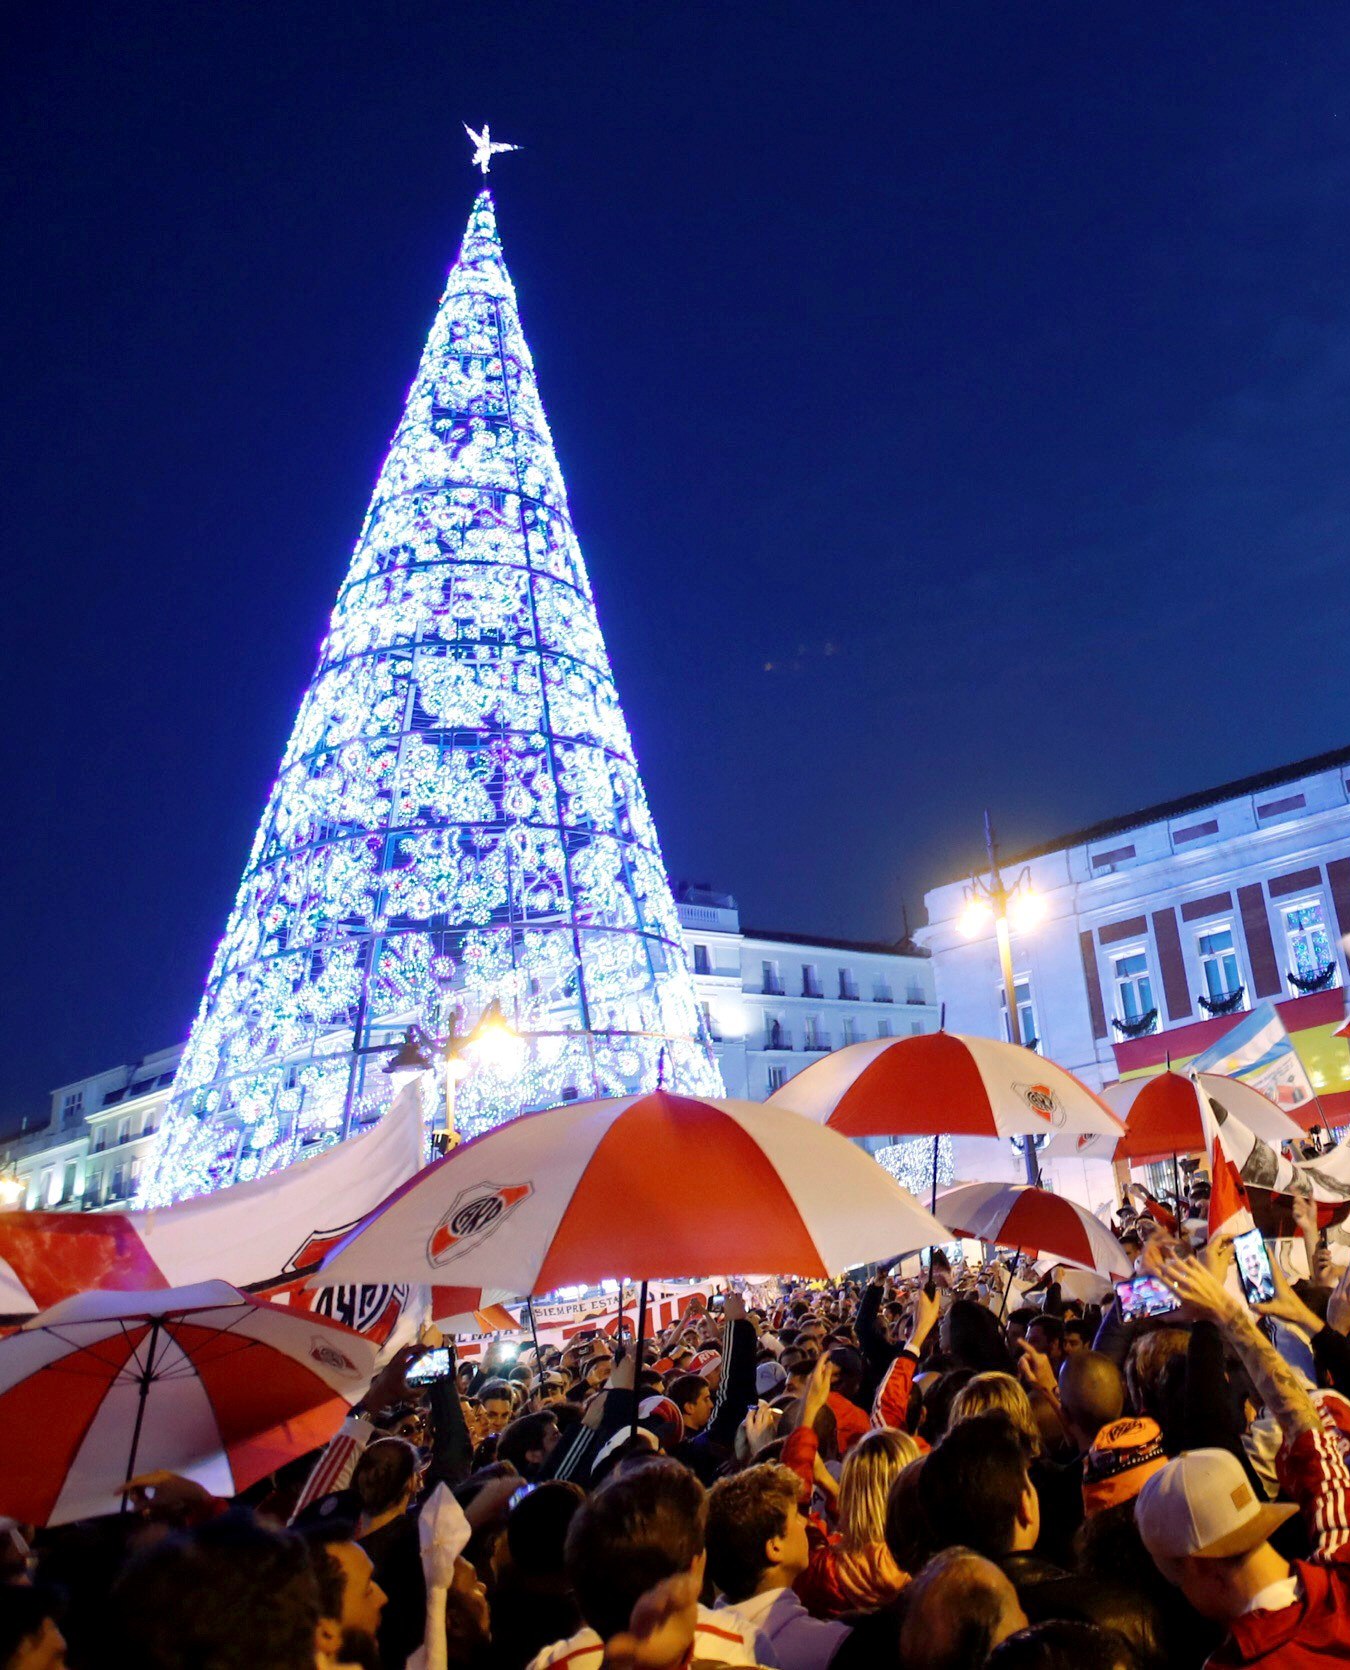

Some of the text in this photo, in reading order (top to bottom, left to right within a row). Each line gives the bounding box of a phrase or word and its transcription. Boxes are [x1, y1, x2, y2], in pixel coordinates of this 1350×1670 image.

[451, 1197, 503, 1235] CARP
[534, 1303, 587, 1317] SIEMPRE
[591, 1288, 635, 1310] ESTAA
